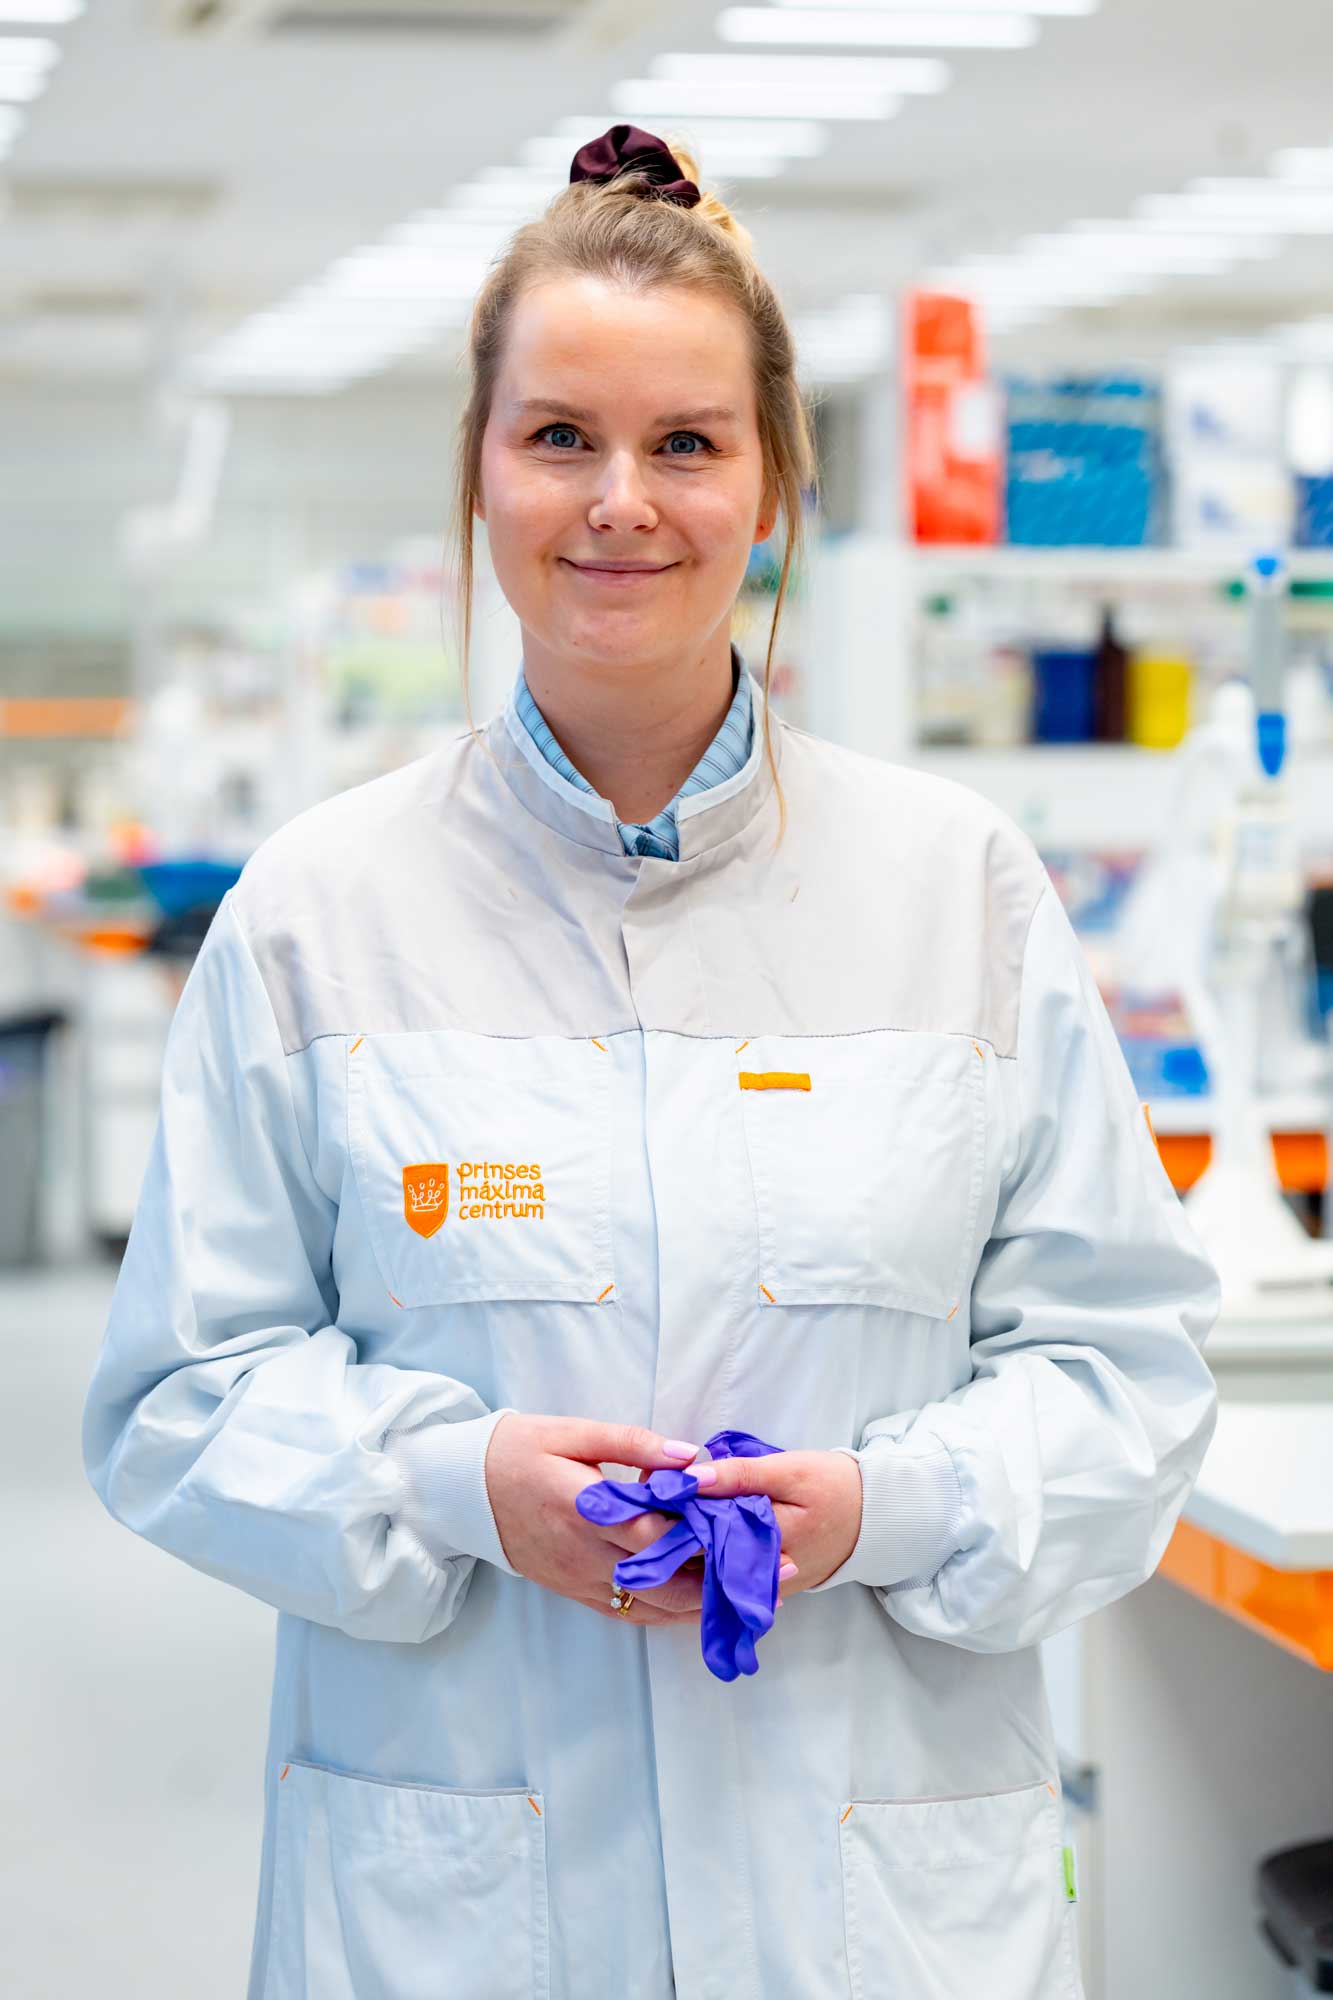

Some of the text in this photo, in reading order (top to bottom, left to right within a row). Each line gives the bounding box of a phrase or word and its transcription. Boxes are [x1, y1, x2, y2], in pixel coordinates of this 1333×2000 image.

[456, 1161, 541, 1184] prinses
[460, 1181, 546, 1201] máxima
[459, 1201, 544, 1219] centrum
